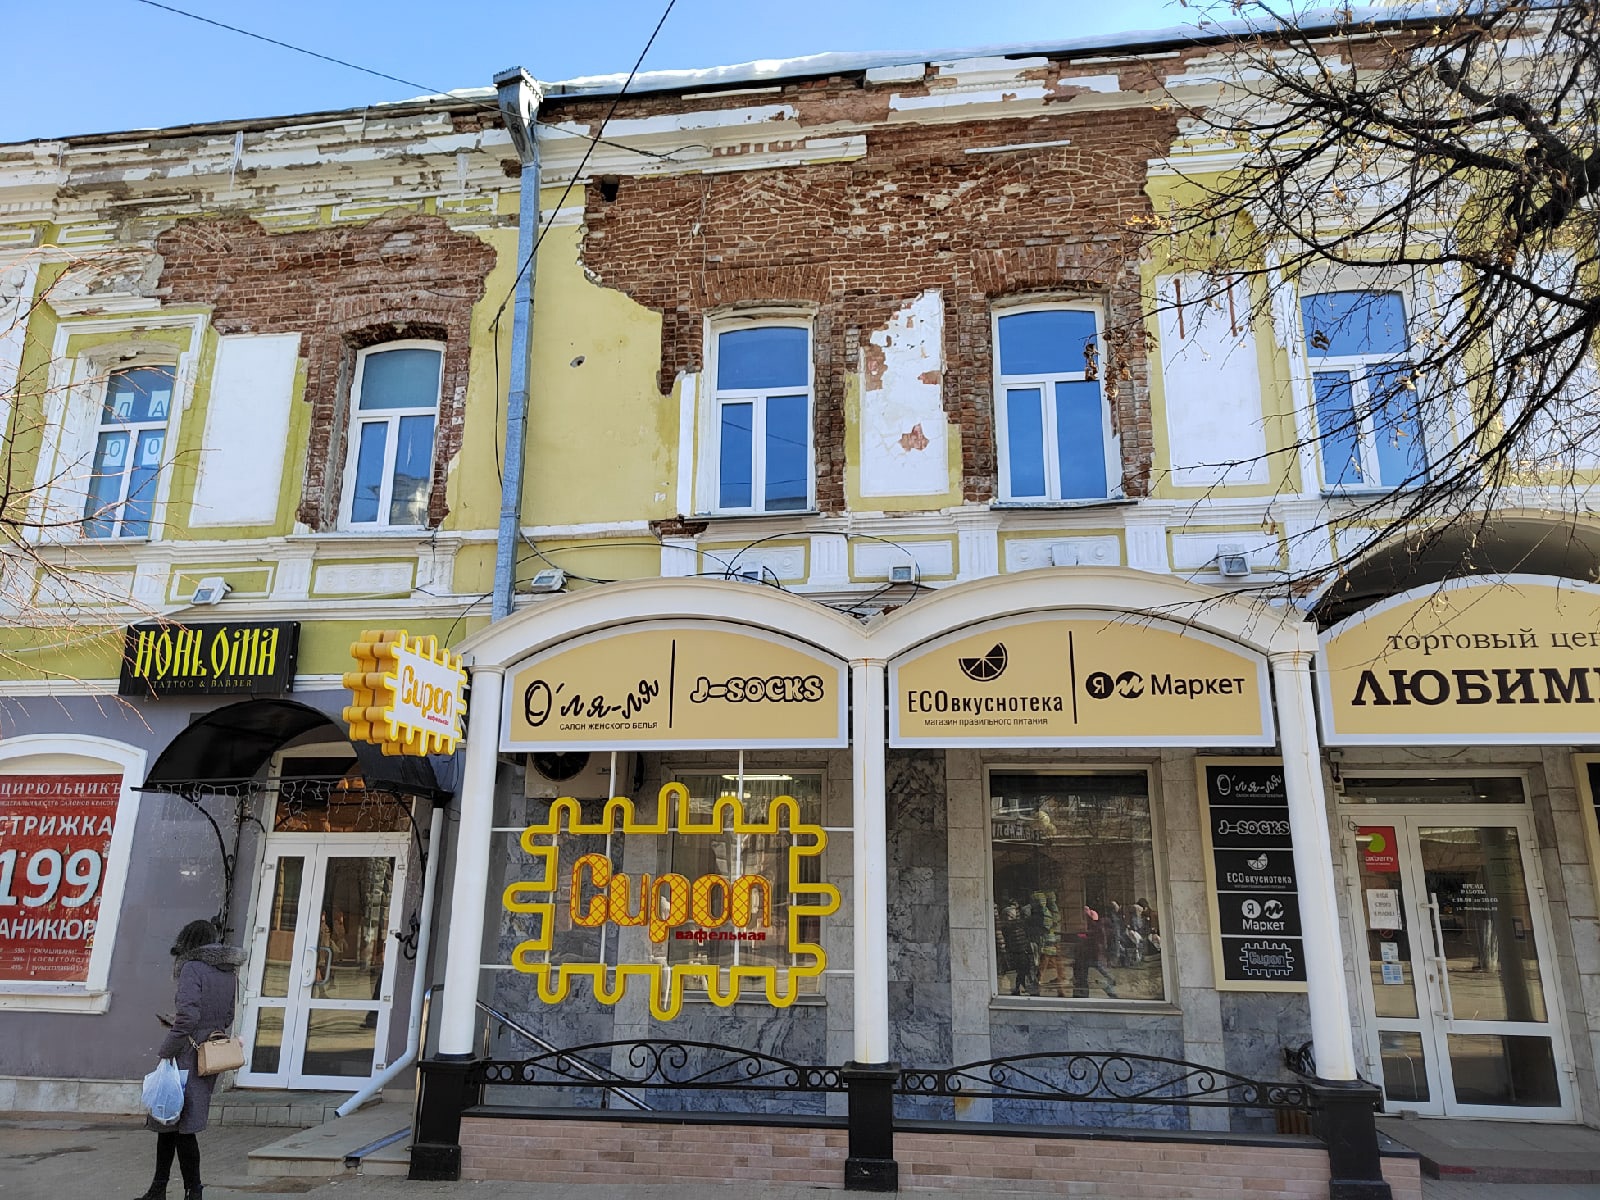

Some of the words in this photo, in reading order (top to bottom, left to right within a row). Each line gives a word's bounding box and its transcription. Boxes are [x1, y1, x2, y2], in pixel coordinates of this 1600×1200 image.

[1387, 628, 1540, 656] торговый
[152, 680, 194, 689] TATTOO
[211, 679, 253, 688] BARBER
[401, 664, 453, 719] Сироп
[689, 675, 825, 704] J-SOCKS
[1150, 673, 1246, 700] Маркет
[1351, 667, 1600, 706] ЛЮБИМ
[559, 722, 586, 731] САЛОН
[588, 722, 631, 730] ЖЕНСКОГО
[632, 721, 658, 729] БЕЛЬЯ
[924, 718, 958, 727] магазин
[959, 719, 1012, 728] правильного
[1013, 717, 1049, 726] питания
[1218, 819, 1291, 835] J-SOCKS
[0, 848, 102, 908] 199
[569, 853, 774, 943] Сироп
[675, 928, 767, 944] вафельная
[1242, 919, 1286, 932] Маркет
